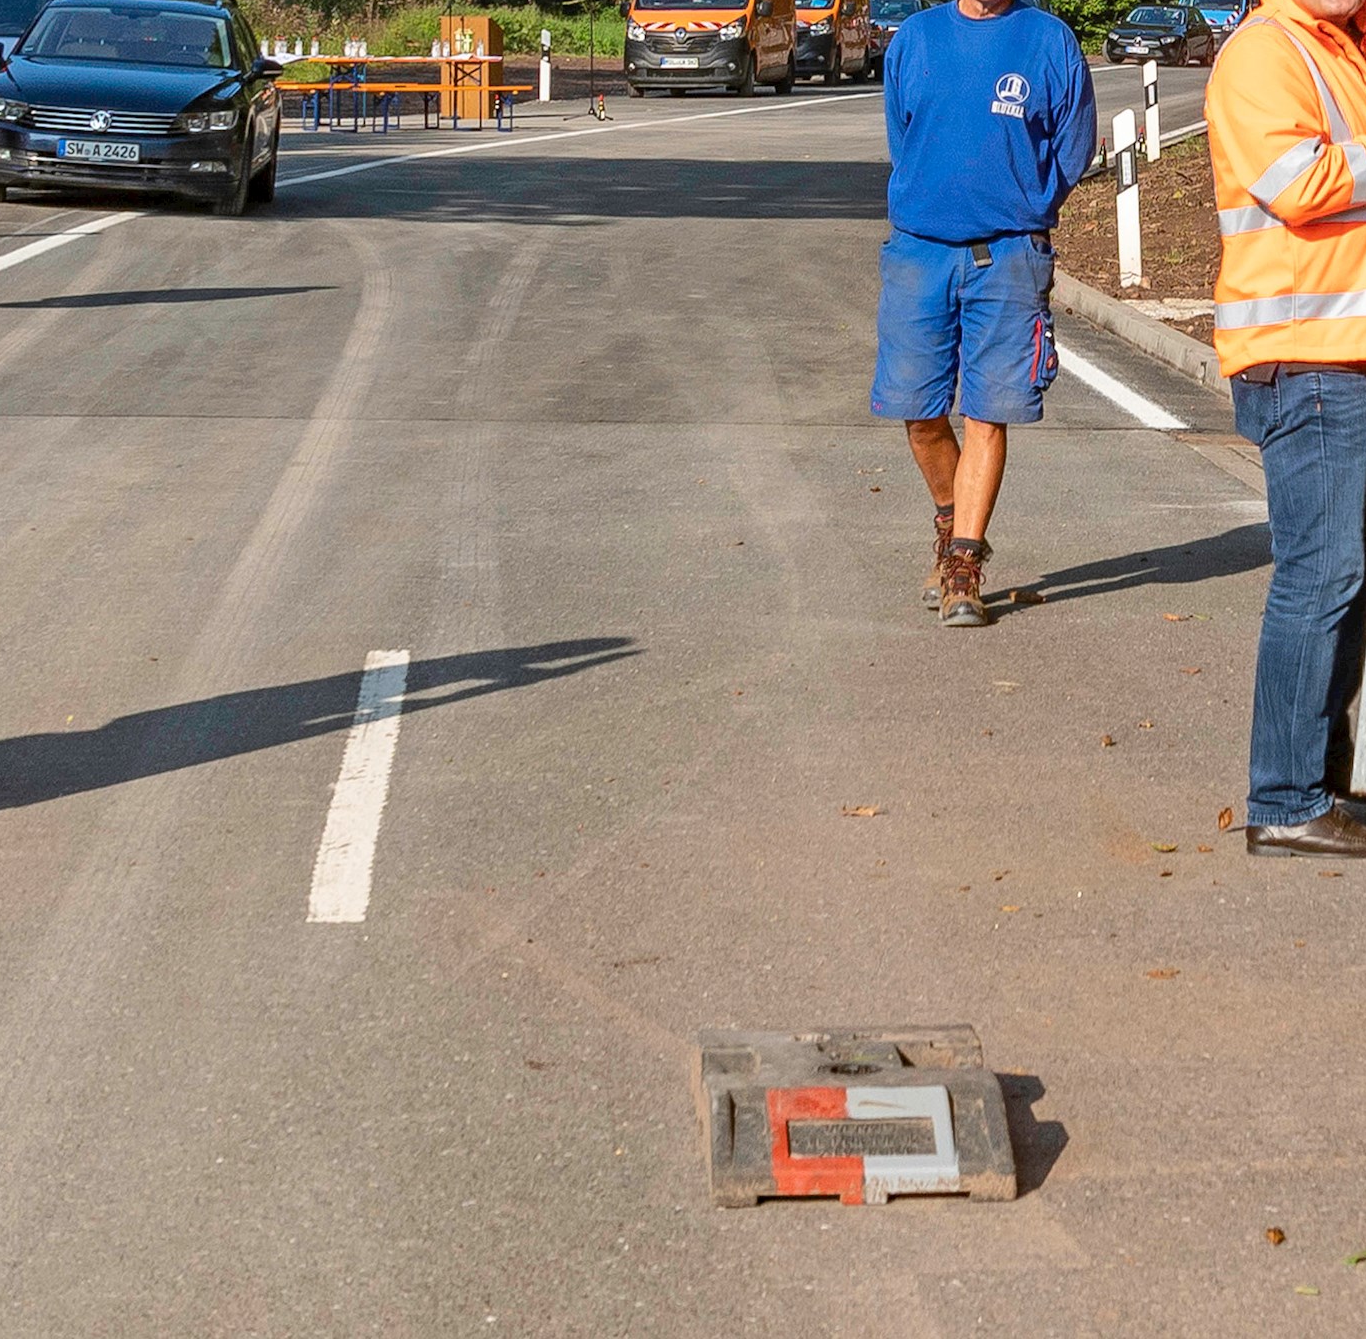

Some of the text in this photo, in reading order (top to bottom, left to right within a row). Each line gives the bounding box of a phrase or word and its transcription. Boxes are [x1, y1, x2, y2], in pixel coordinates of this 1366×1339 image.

[67, 142, 137, 159] SW A 2426
